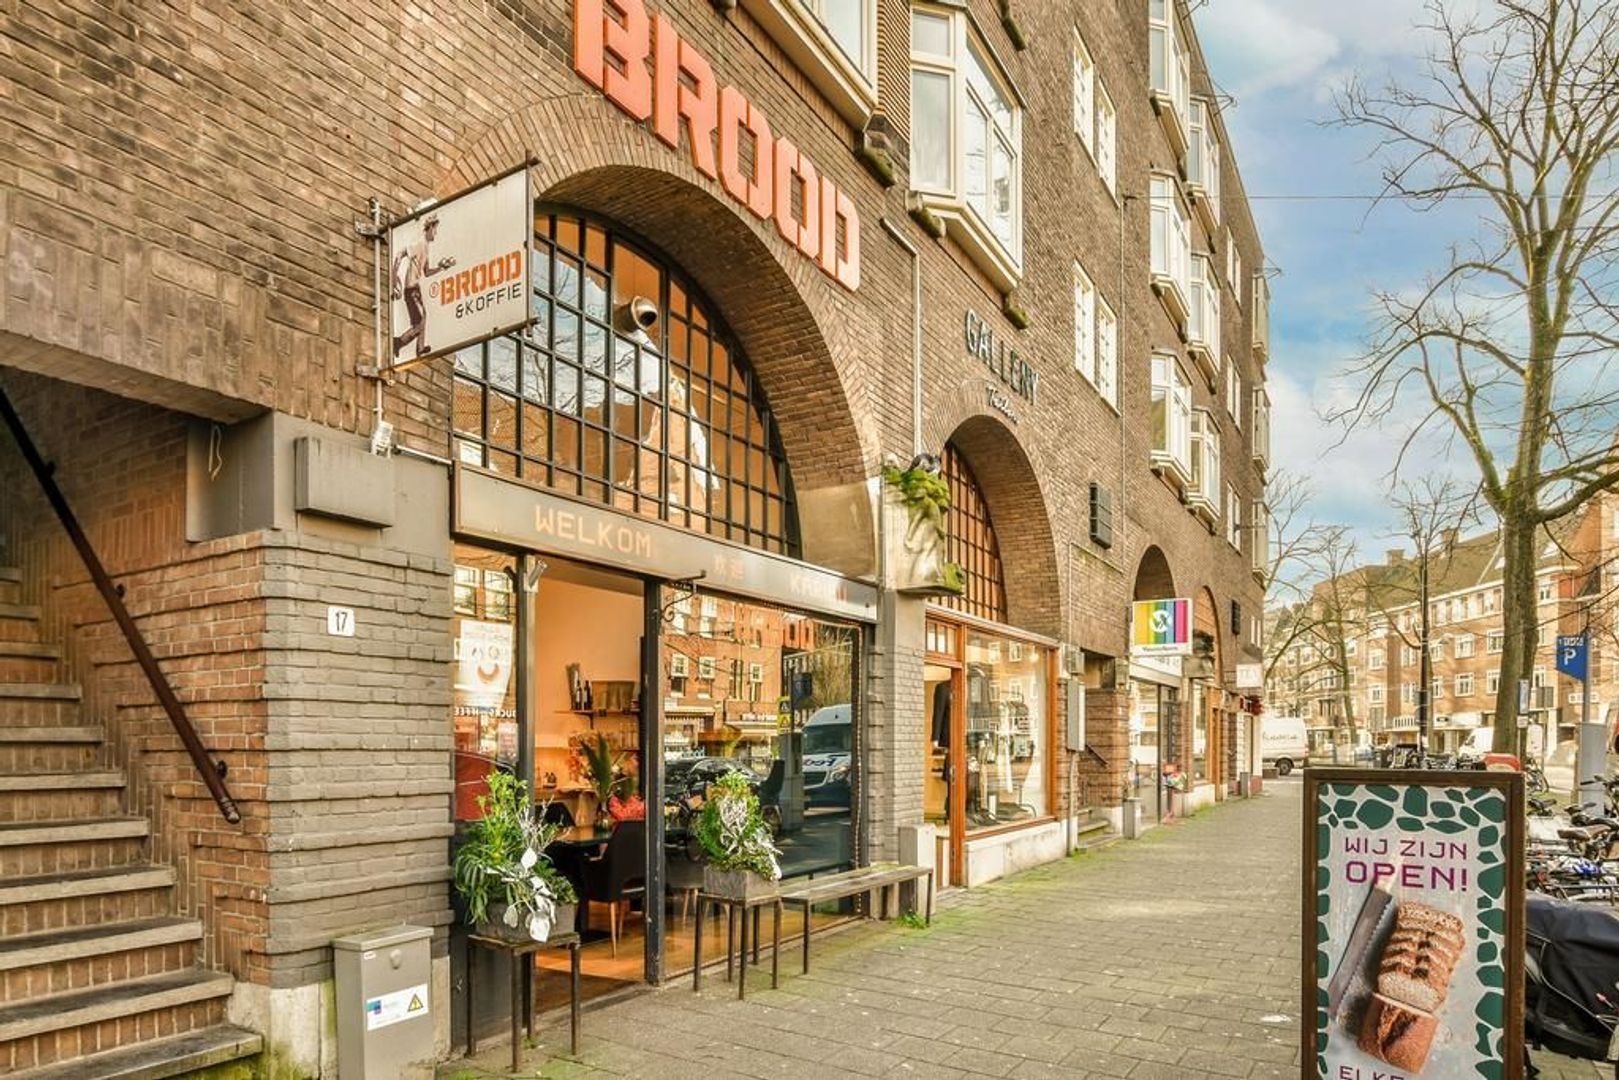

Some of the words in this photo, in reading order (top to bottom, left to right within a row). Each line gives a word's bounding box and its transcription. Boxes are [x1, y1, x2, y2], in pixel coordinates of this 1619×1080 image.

[573, 0, 860, 292] BROOD
[440, 250, 521, 306] BROOD
[455, 282, 522, 319] &KOFFIE
[964, 308, 1039, 406] GALLERY
[535, 505, 651, 558] WELKOM
[335, 611, 348, 632] 17
[1563, 648, 1577, 665] P
[1344, 837, 1388, 855] WIJ
[1399, 839, 1467, 860] ZIJN
[1345, 860, 1467, 892] OPEN!
